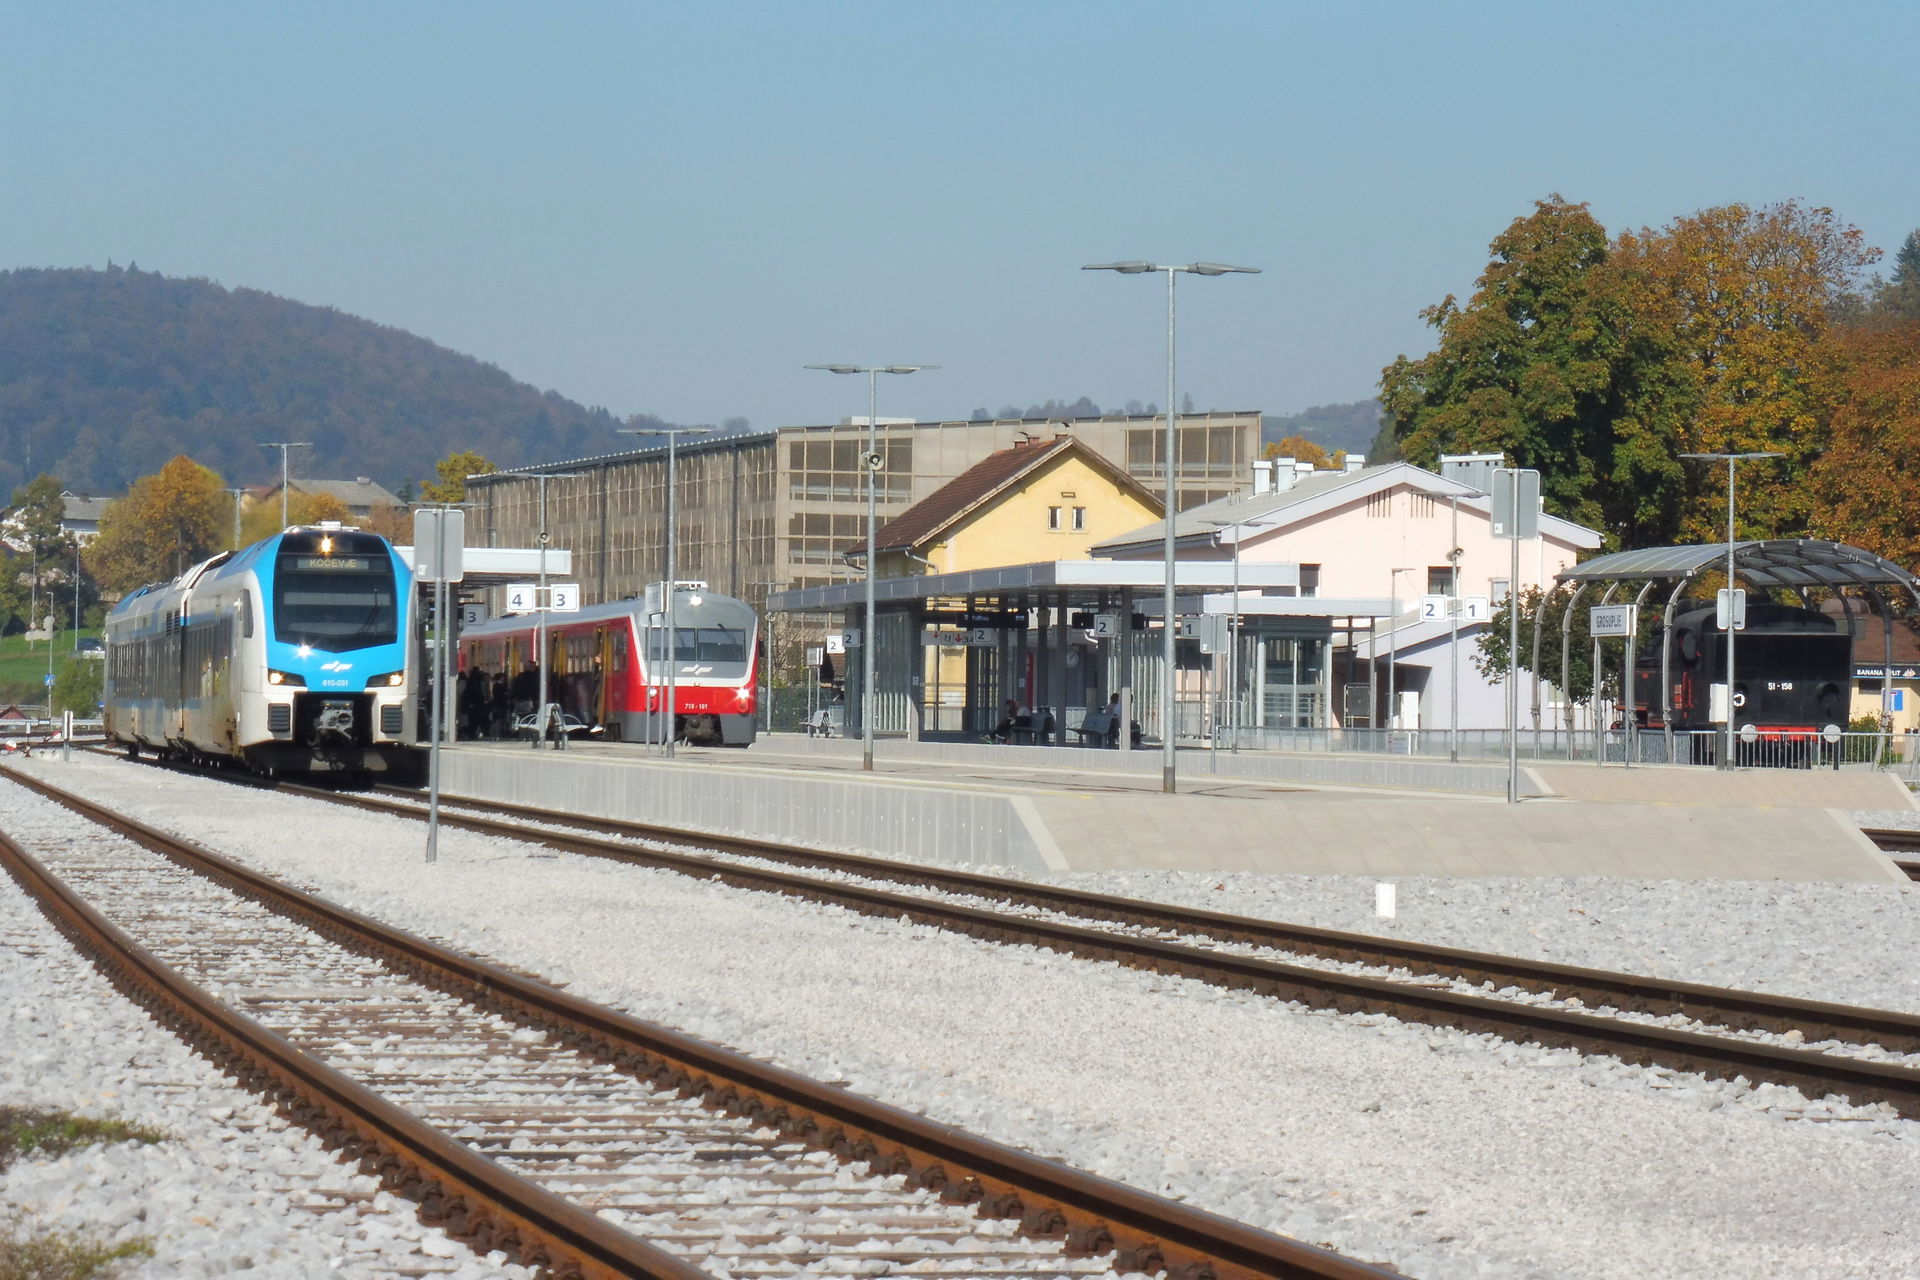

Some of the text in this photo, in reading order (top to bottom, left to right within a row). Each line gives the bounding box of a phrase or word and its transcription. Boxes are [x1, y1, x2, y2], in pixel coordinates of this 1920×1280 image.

[512, 594, 523, 607] 4
[556, 593, 566, 607] 3
[1425, 603, 1435, 617] 2
[1468, 604, 1476, 617] 1
[468, 611, 477, 623] 3
[1099, 622, 1107, 633] 2
[1185, 623, 1193, 635] 1
[845, 634, 852, 644] 2
[977, 629, 985, 640] 2
[830, 641, 837, 650] 2
